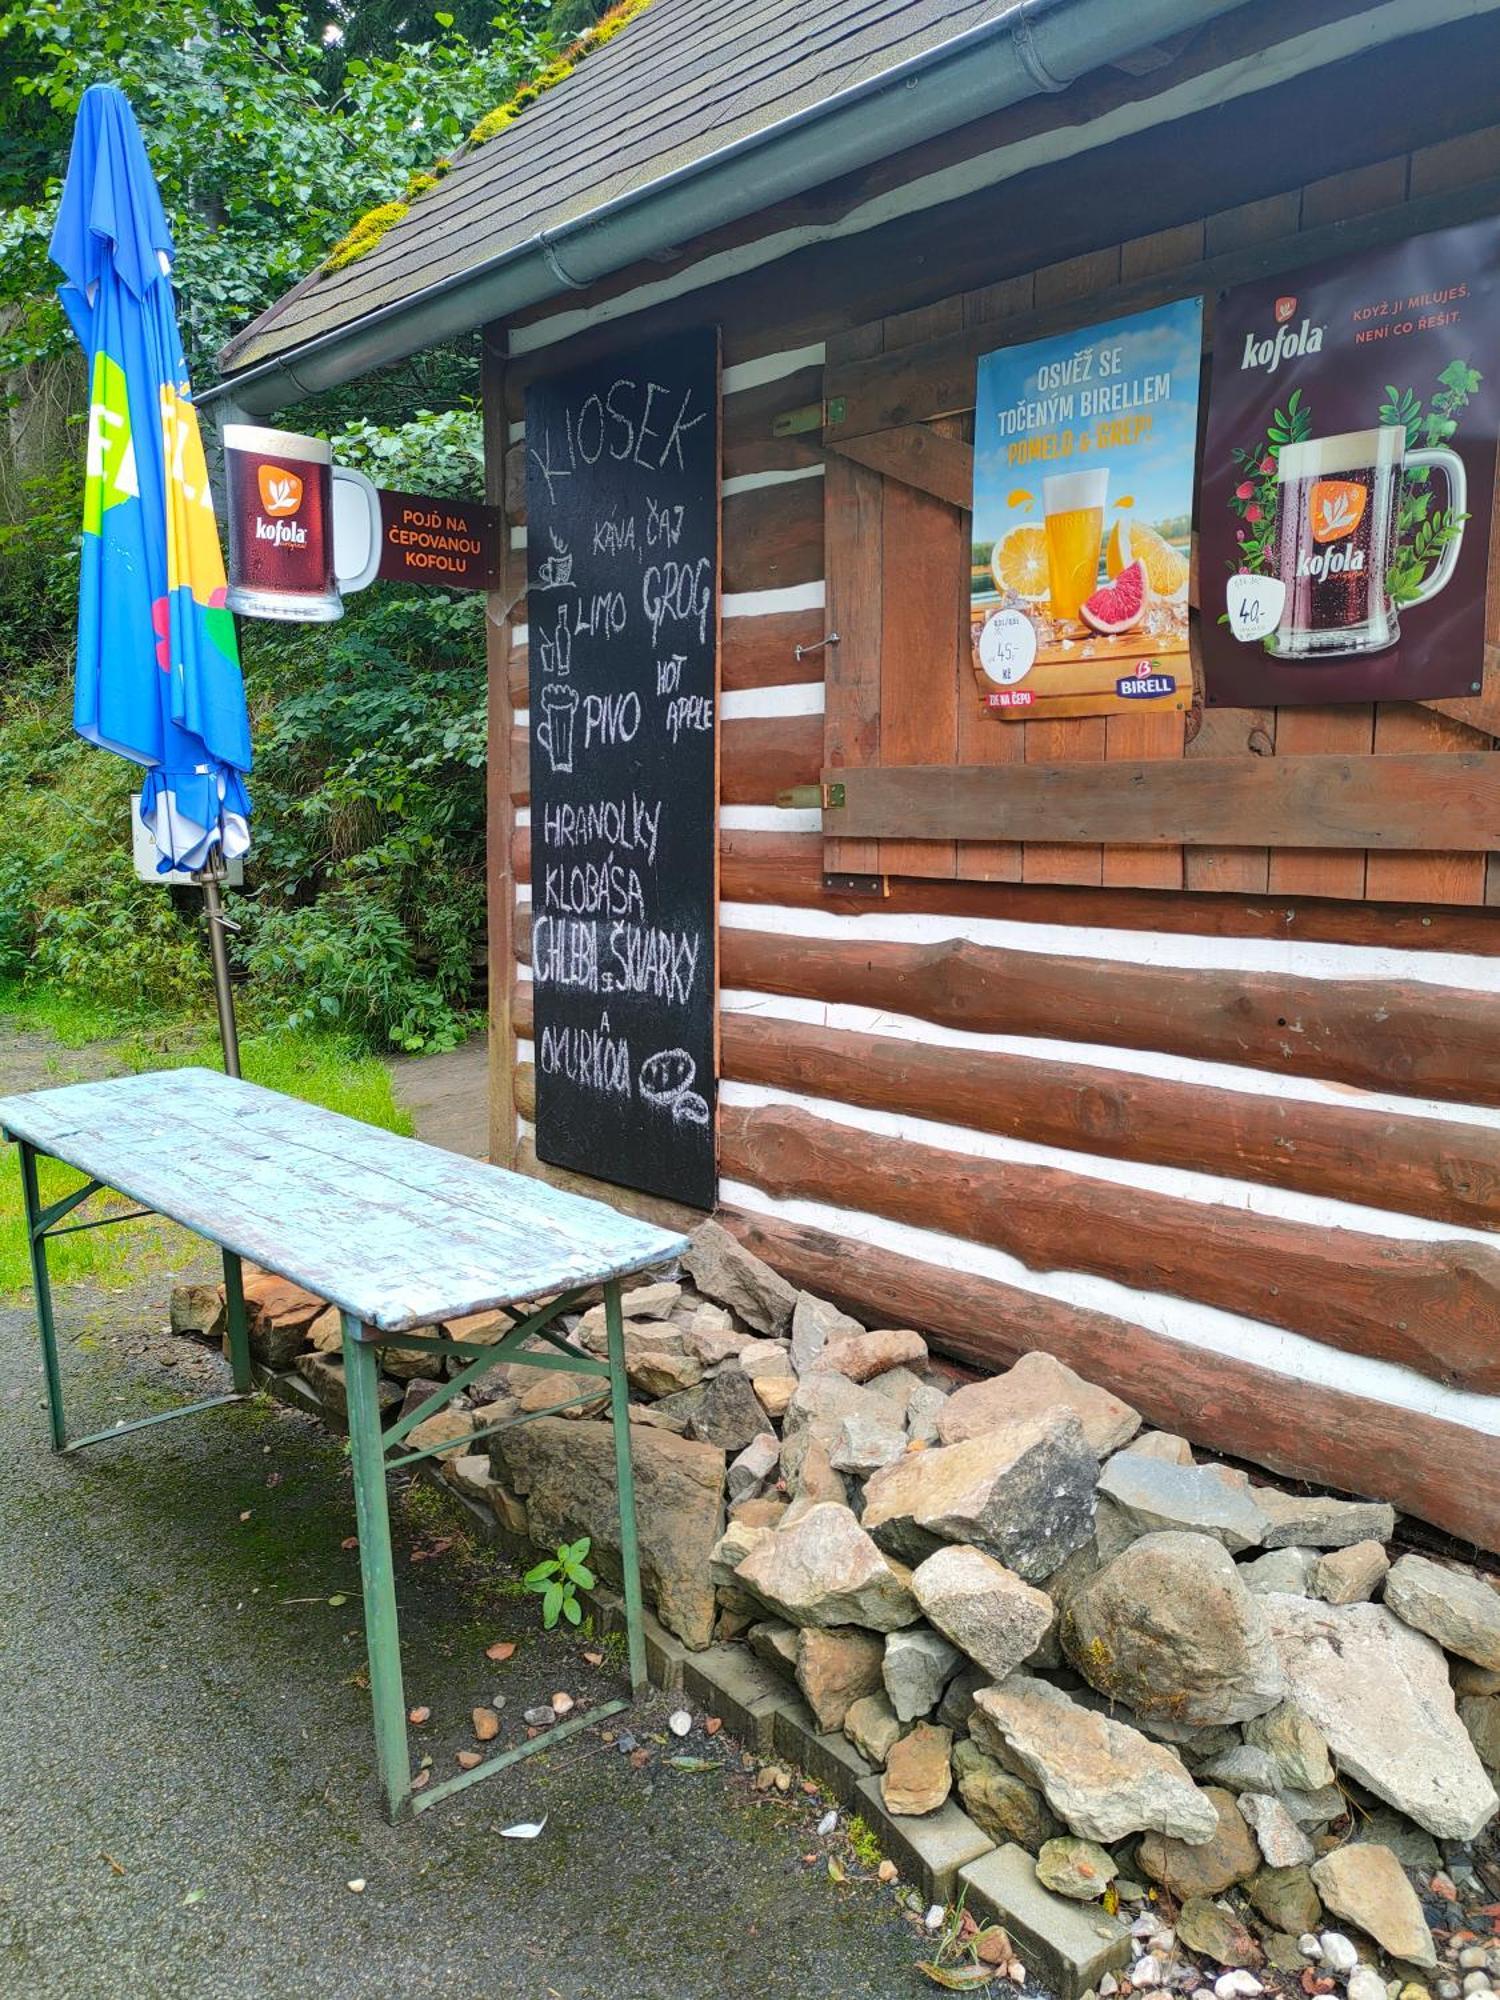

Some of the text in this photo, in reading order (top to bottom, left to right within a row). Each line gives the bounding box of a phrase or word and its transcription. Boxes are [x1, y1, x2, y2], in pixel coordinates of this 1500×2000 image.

[1353, 300, 1389, 321] KDYŽ
[1391, 301, 1404, 315] JI
[1355, 324, 1389, 344] NENÍ
[1393, 321, 1413, 335] CO
[1241, 319, 1323, 374] kofola
[1038, 347, 1123, 392] OSVĚŽ SE
[998, 373, 1171, 437] TOČENÝM BIRELLEM
[531, 379, 706, 505] KIOSEK
[1008, 429, 1073, 466] POMELO
[255, 516, 306, 547] kofola
[388, 524, 480, 554] ČEPOVANOU
[403, 510, 467, 533] POJĎ NA
[646, 496, 684, 549] ČAJ
[405, 551, 467, 572] KOFOLU
[1296, 543, 1364, 583] kofola
[574, 592, 627, 641] LIMO
[643, 557, 710, 648] GROG
[657, 654, 687, 696] HOT
[1121, 679, 1171, 695] BIRELL
[583, 691, 641, 748] PIVO
[666, 695, 713, 744] APPLE
[544, 791, 661, 867] HRANOLKY
[545, 851, 645, 921] KLOBÁSA
